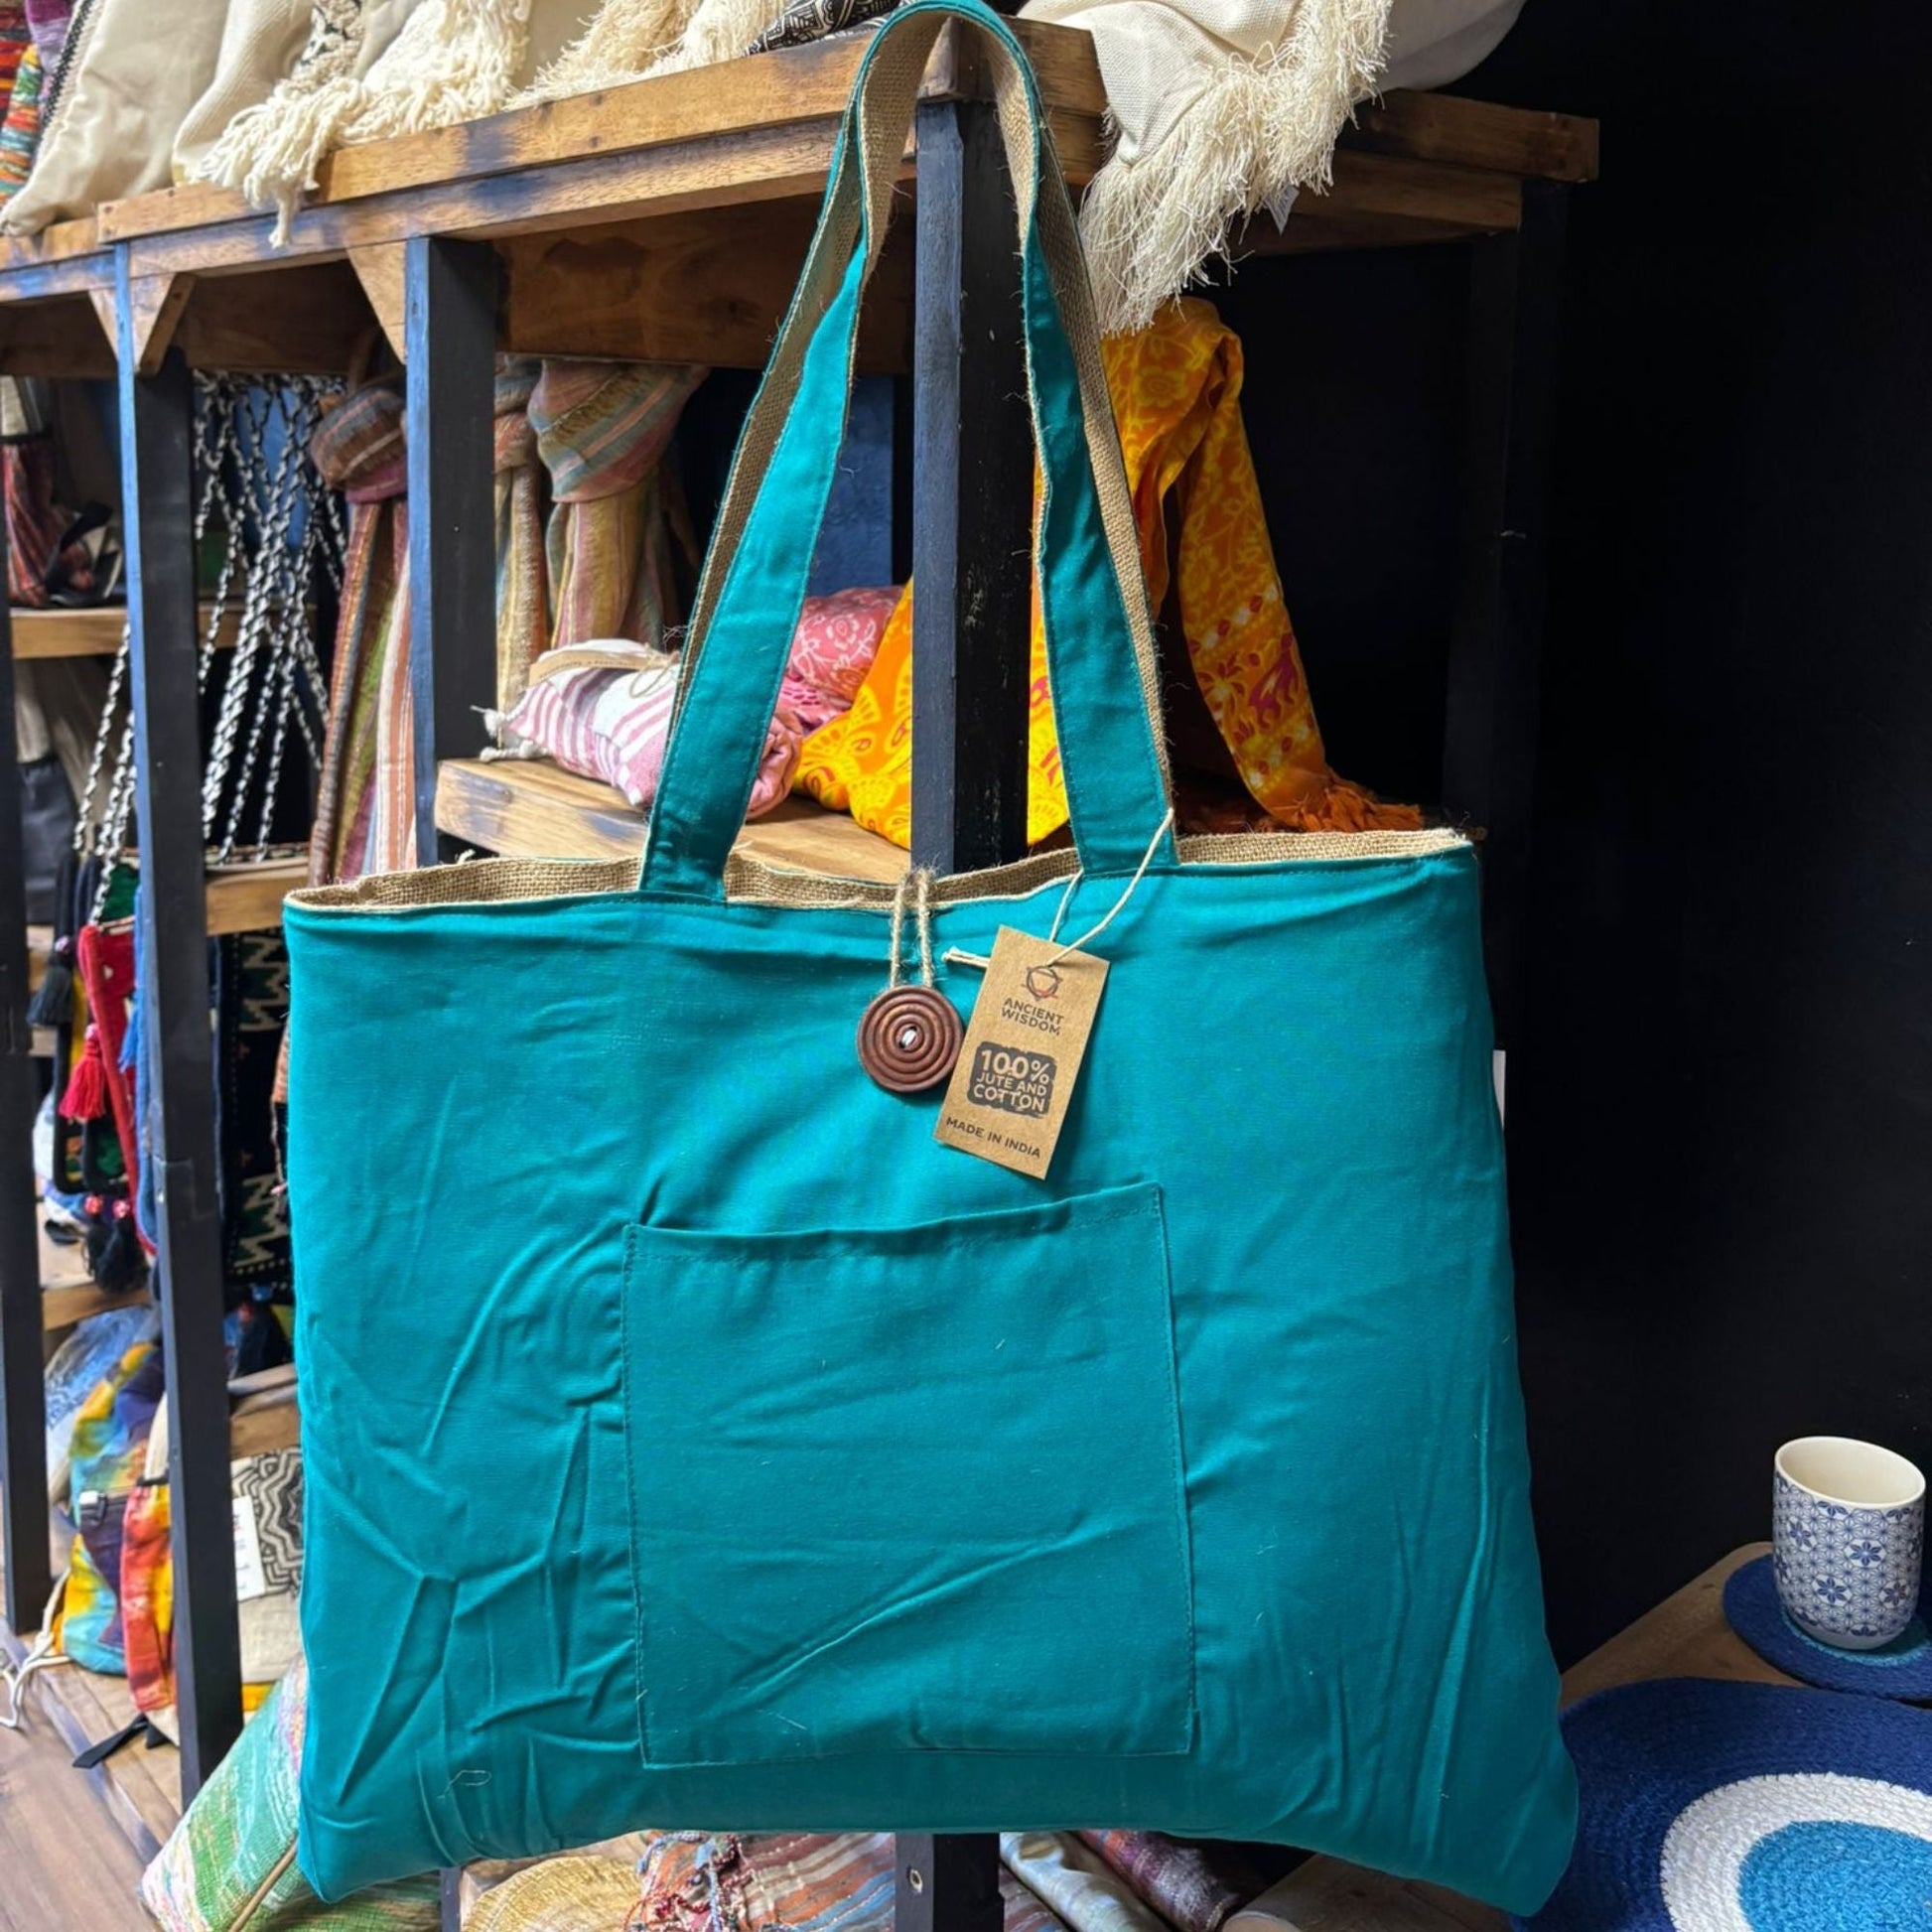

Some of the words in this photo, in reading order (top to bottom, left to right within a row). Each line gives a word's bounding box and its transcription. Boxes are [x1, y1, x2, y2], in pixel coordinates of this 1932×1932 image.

[1002, 1007, 1061, 1035] WISDOM
[1004, 998, 1064, 1025] ANCIENT
[981, 1049, 1050, 1085] 100%
[973, 1083, 1045, 1112] COTTON
[976, 1072, 1014, 1089] JUTE
[1017, 1080, 1047, 1096] AND
[946, 1116, 985, 1138] MADE
[987, 1131, 1002, 1144] IN
[1005, 1137, 1040, 1159] INDIA
